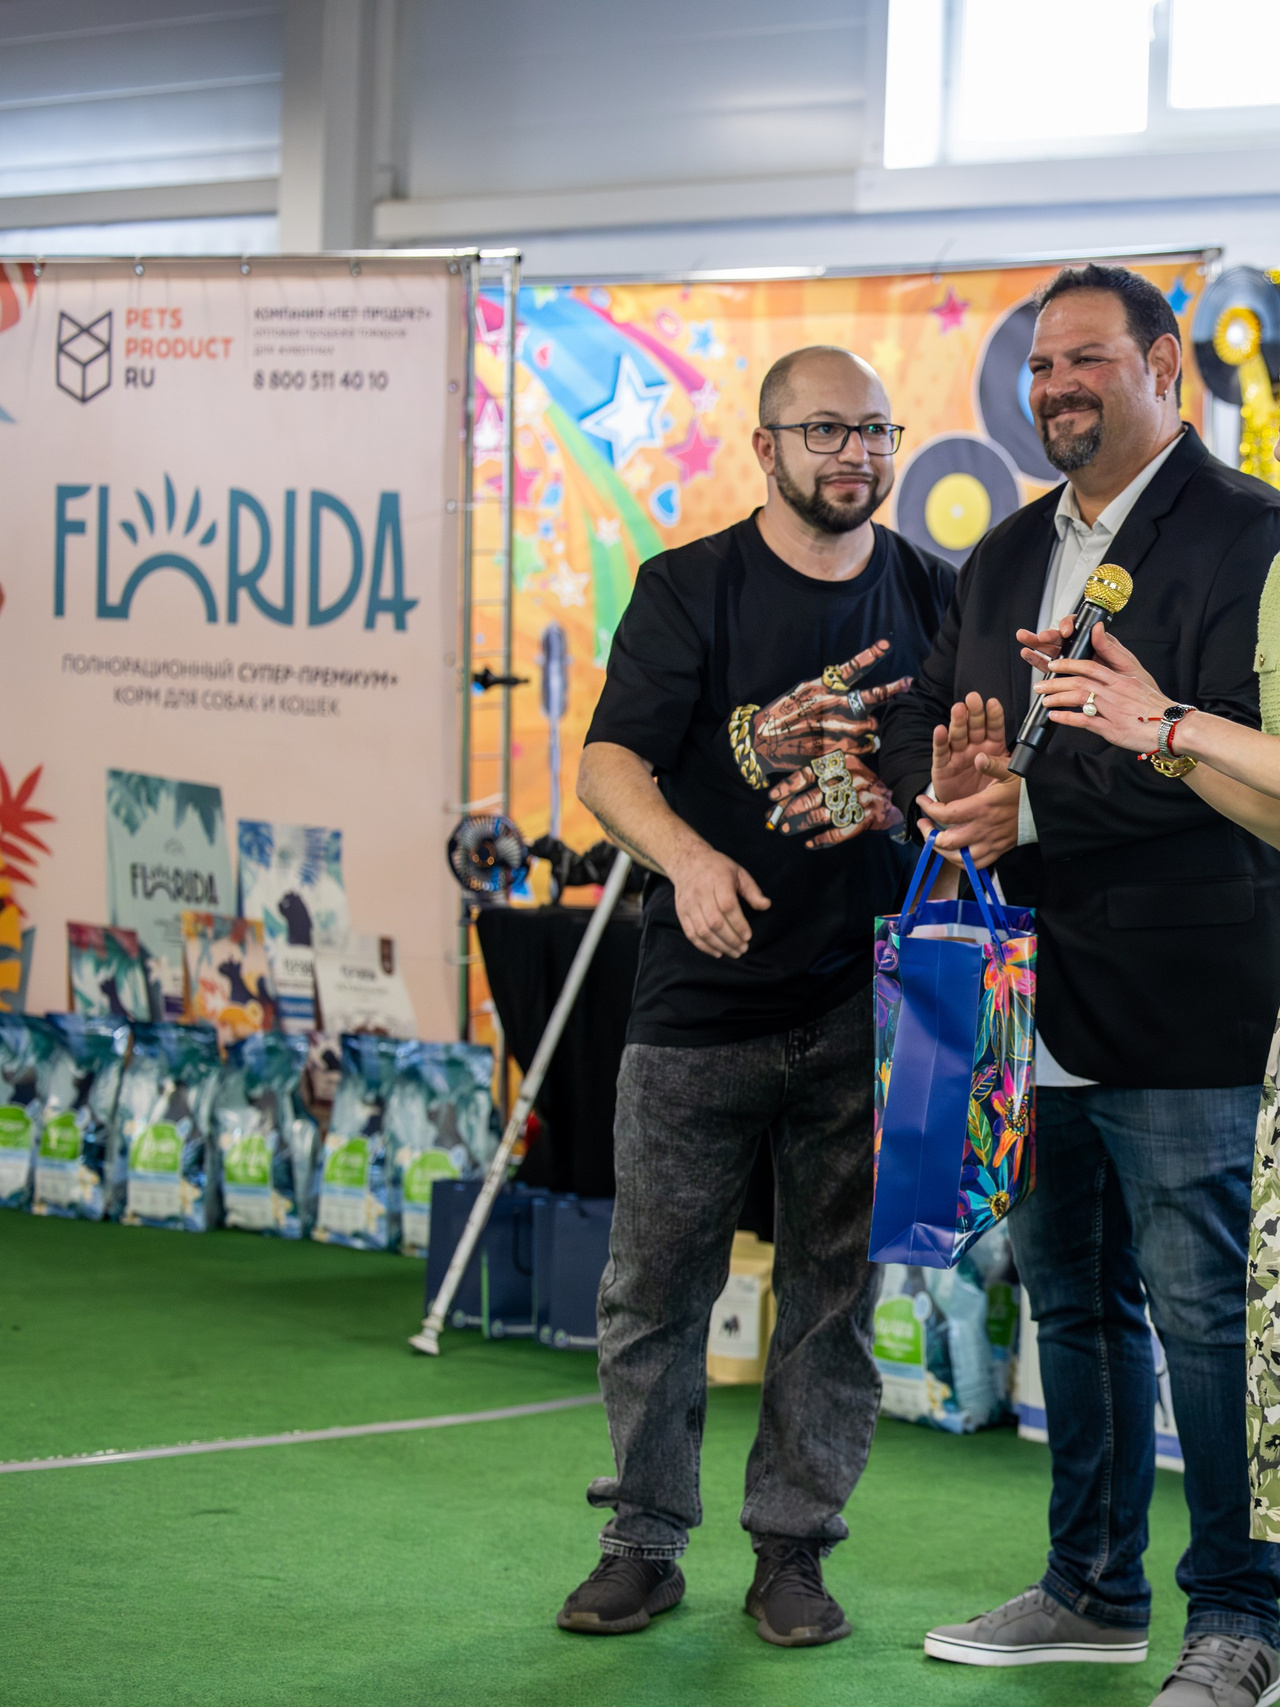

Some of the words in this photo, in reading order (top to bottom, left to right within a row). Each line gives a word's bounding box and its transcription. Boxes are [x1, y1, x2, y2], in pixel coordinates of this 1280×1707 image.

[125, 308, 182, 329] PETS
[124, 337, 234, 360] PRODUCT
[125, 366, 155, 389] RU
[253, 369, 265, 390] 8
[268, 369, 306, 390] 800
[310, 369, 335, 390] 511
[339, 369, 364, 390] 40
[368, 369, 389, 390] 10
[54, 471, 419, 632] FLORIDA
[61, 652, 235, 681] ПОЛНОРАЦИОННЫЙ
[113, 685, 161, 708] КОРМ
[163, 687, 198, 709] ДЛЯ
[201, 688, 259, 712] СОБАК
[261, 693, 276, 713] И
[279, 694, 341, 717] КОШЕК
[810, 748, 865, 828] BOSS
[129, 861, 219, 906] FLORIDA
